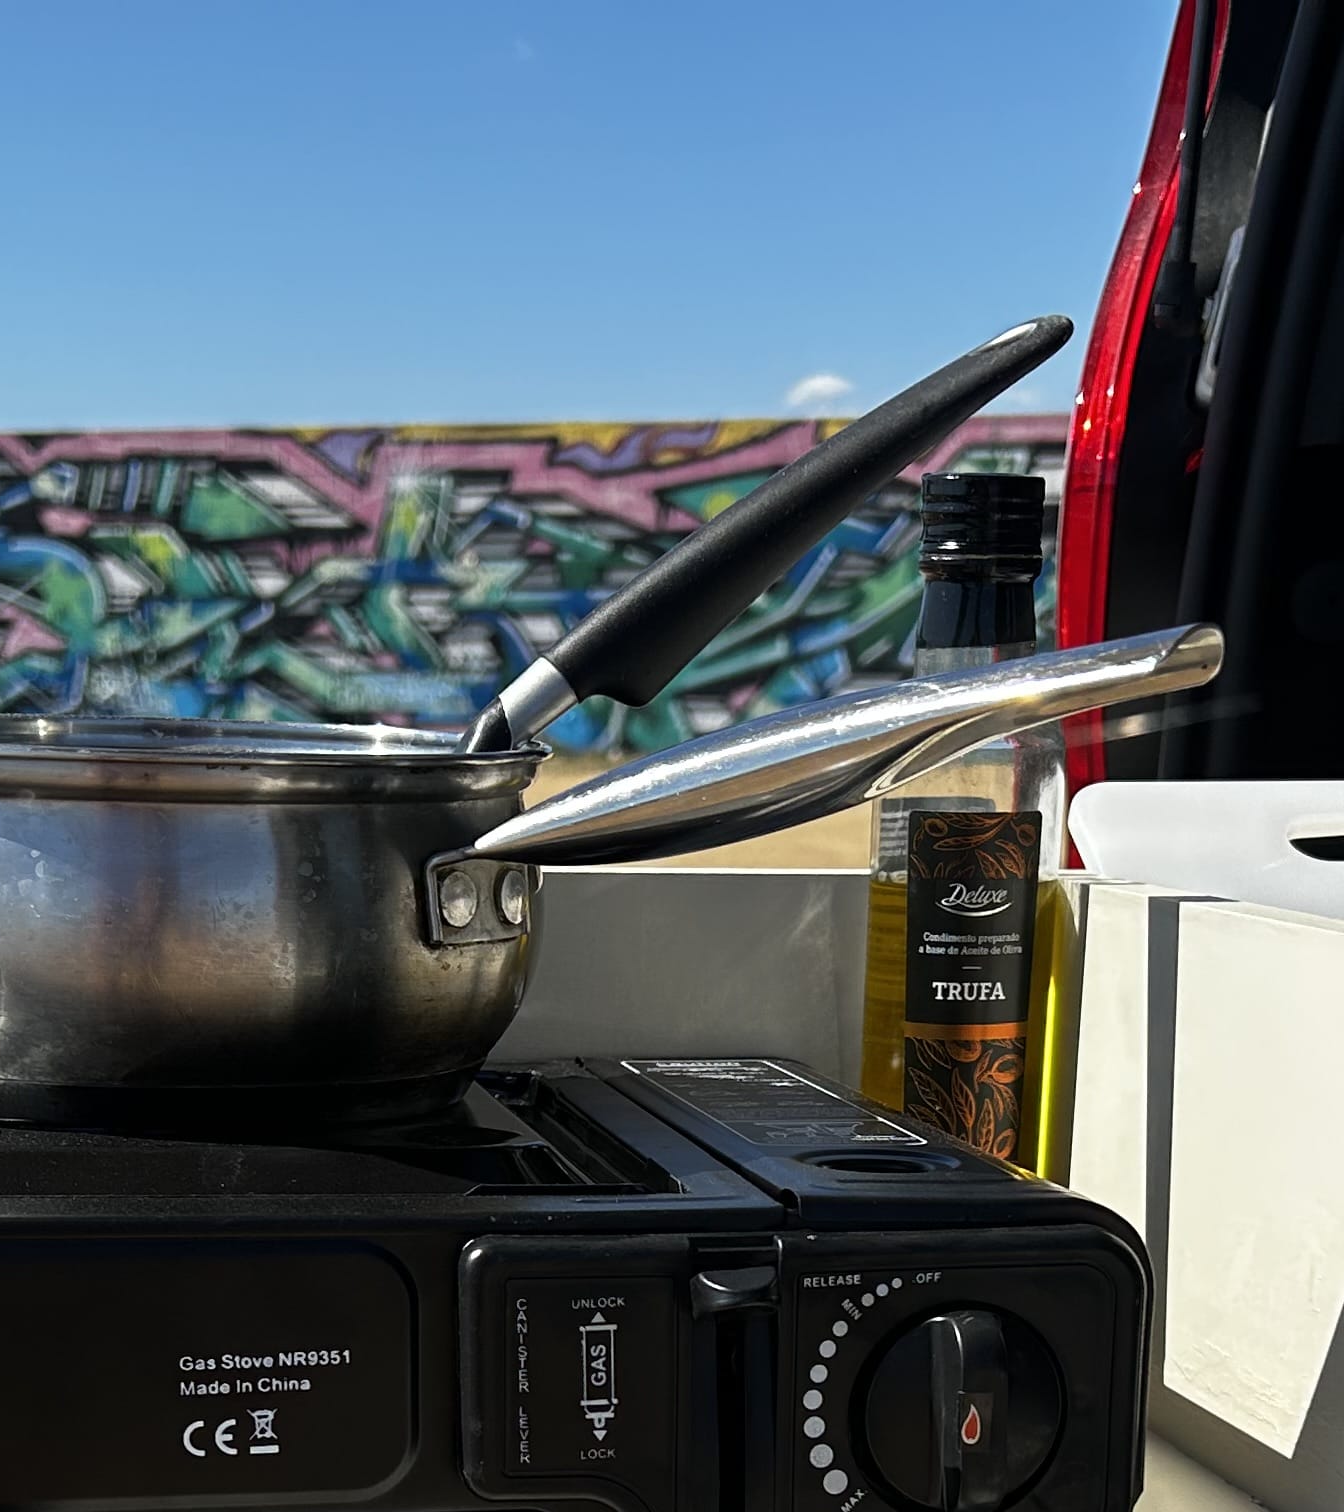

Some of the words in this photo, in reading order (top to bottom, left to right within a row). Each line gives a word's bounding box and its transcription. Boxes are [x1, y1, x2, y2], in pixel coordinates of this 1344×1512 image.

[940, 883, 1009, 909] Deluxe
[922, 931, 976, 943] Condimento
[977, 933, 1021, 946] preparado
[925, 944, 946, 955] base
[947, 945, 960, 955] de
[960, 946, 990, 956] Aceite
[990, 945, 1001, 955] de
[931, 981, 1006, 1001] TRUFA
[802, 1274, 863, 1289] RELEASE
[914, 1271, 943, 1285] OFF
[571, 1296, 627, 1311] UNLOCK
[840, 1297, 864, 1321] MIN
[515, 1298, 531, 1393] CANISTER
[178, 1355, 217, 1372] Gas
[220, 1353, 275, 1370] Stove
[278, 1348, 353, 1368] NR9351
[590, 1343, 608, 1388] GAS
[179, 1379, 232, 1397] Made
[256, 1376, 312, 1393] China
[518, 1406, 532, 1465] LEVER
[578, 1448, 617, 1462] LOCK
